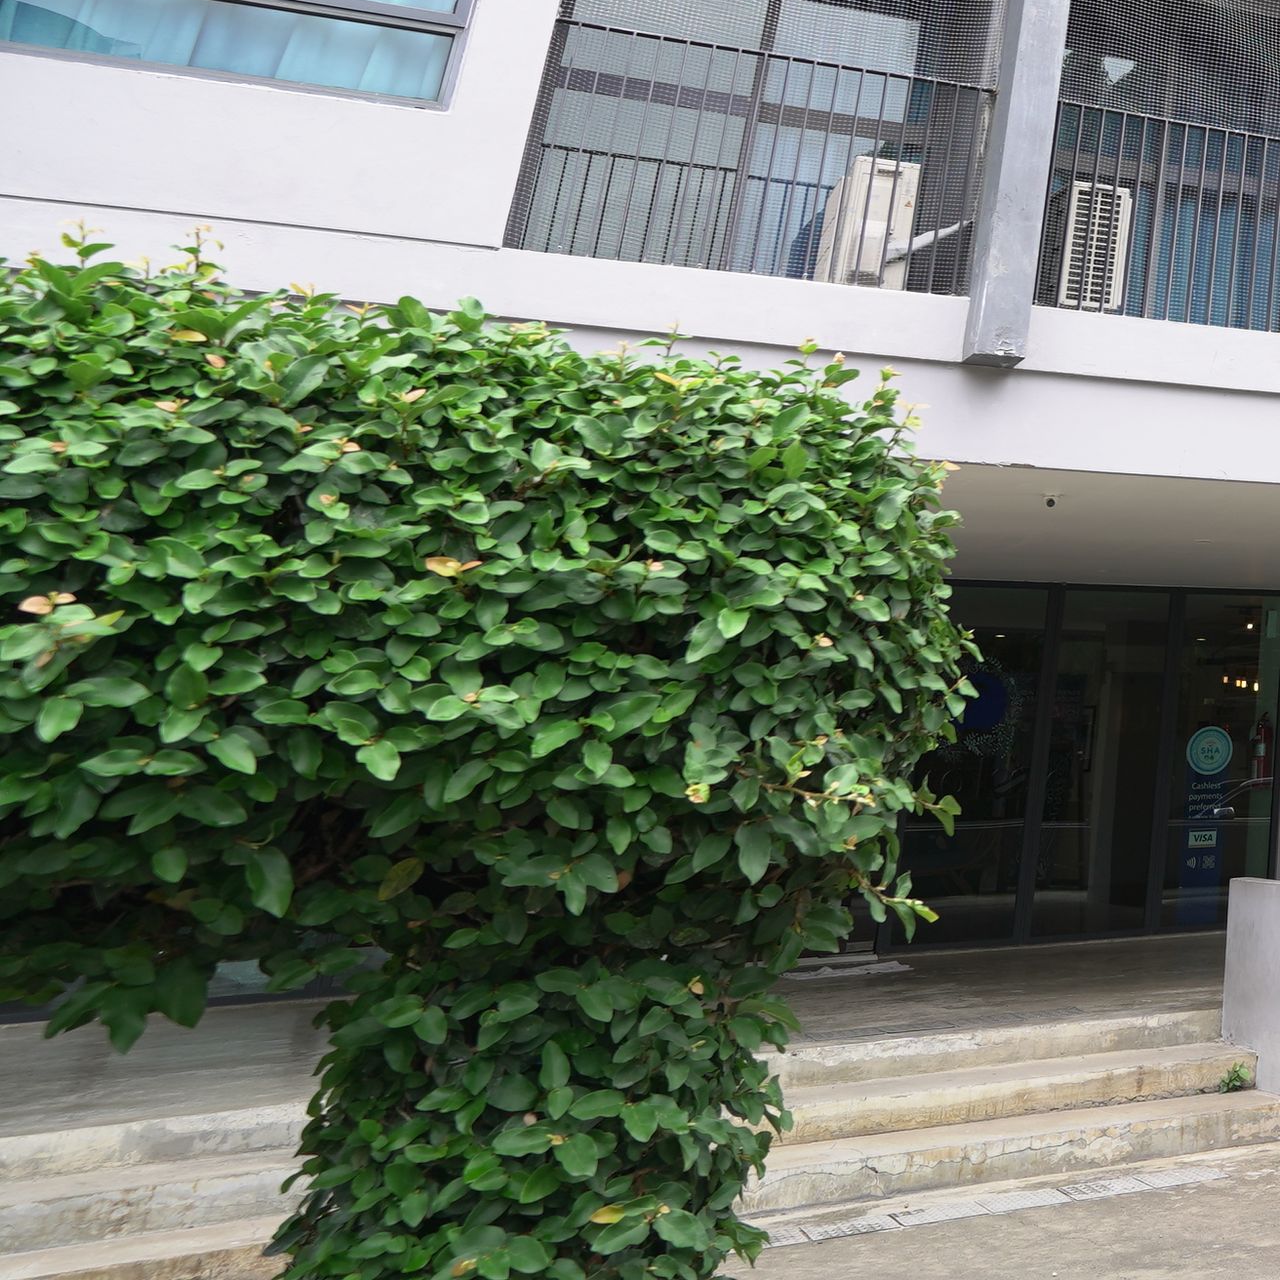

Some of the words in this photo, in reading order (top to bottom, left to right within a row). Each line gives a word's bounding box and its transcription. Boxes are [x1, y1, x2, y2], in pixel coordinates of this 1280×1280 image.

[1191, 782, 1221, 790] Cashless
[1188, 793, 1223, 801] payments
[1194, 834, 1213, 842] VISA
